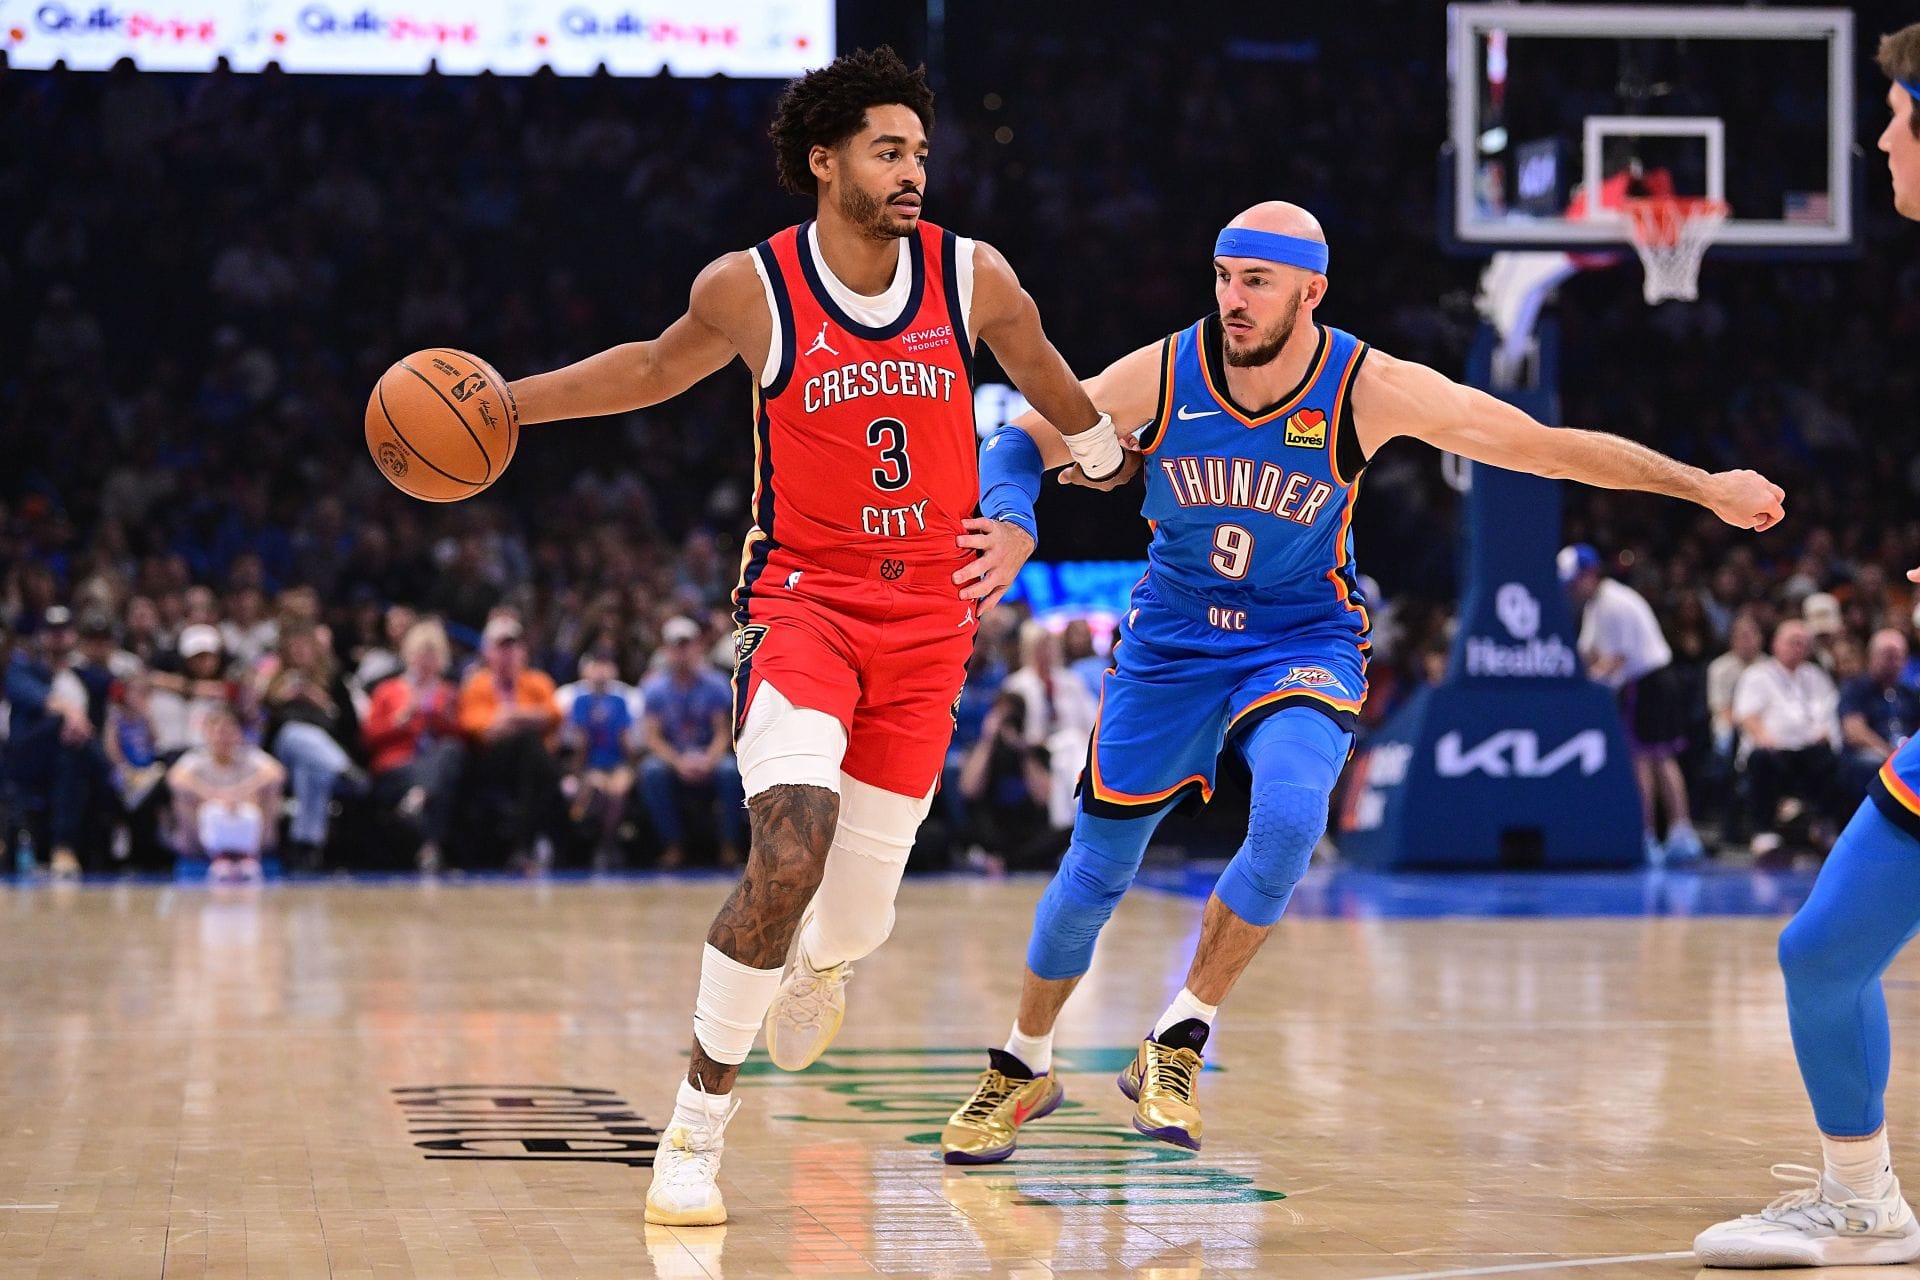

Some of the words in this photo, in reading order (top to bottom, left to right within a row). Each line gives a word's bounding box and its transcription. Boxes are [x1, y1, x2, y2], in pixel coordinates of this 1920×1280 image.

[901, 325, 952, 345] NEWAGE
[907, 338, 950, 352] PRODUCTS
[804, 360, 956, 413] CRESCENT
[866, 416, 912, 491] 3
[1161, 457, 1334, 526] THUNDER
[862, 499, 929, 536] CITY
[1209, 523, 1255, 581] 9
[1208, 606, 1247, 633] OKC
[1466, 636, 1576, 678] Health
